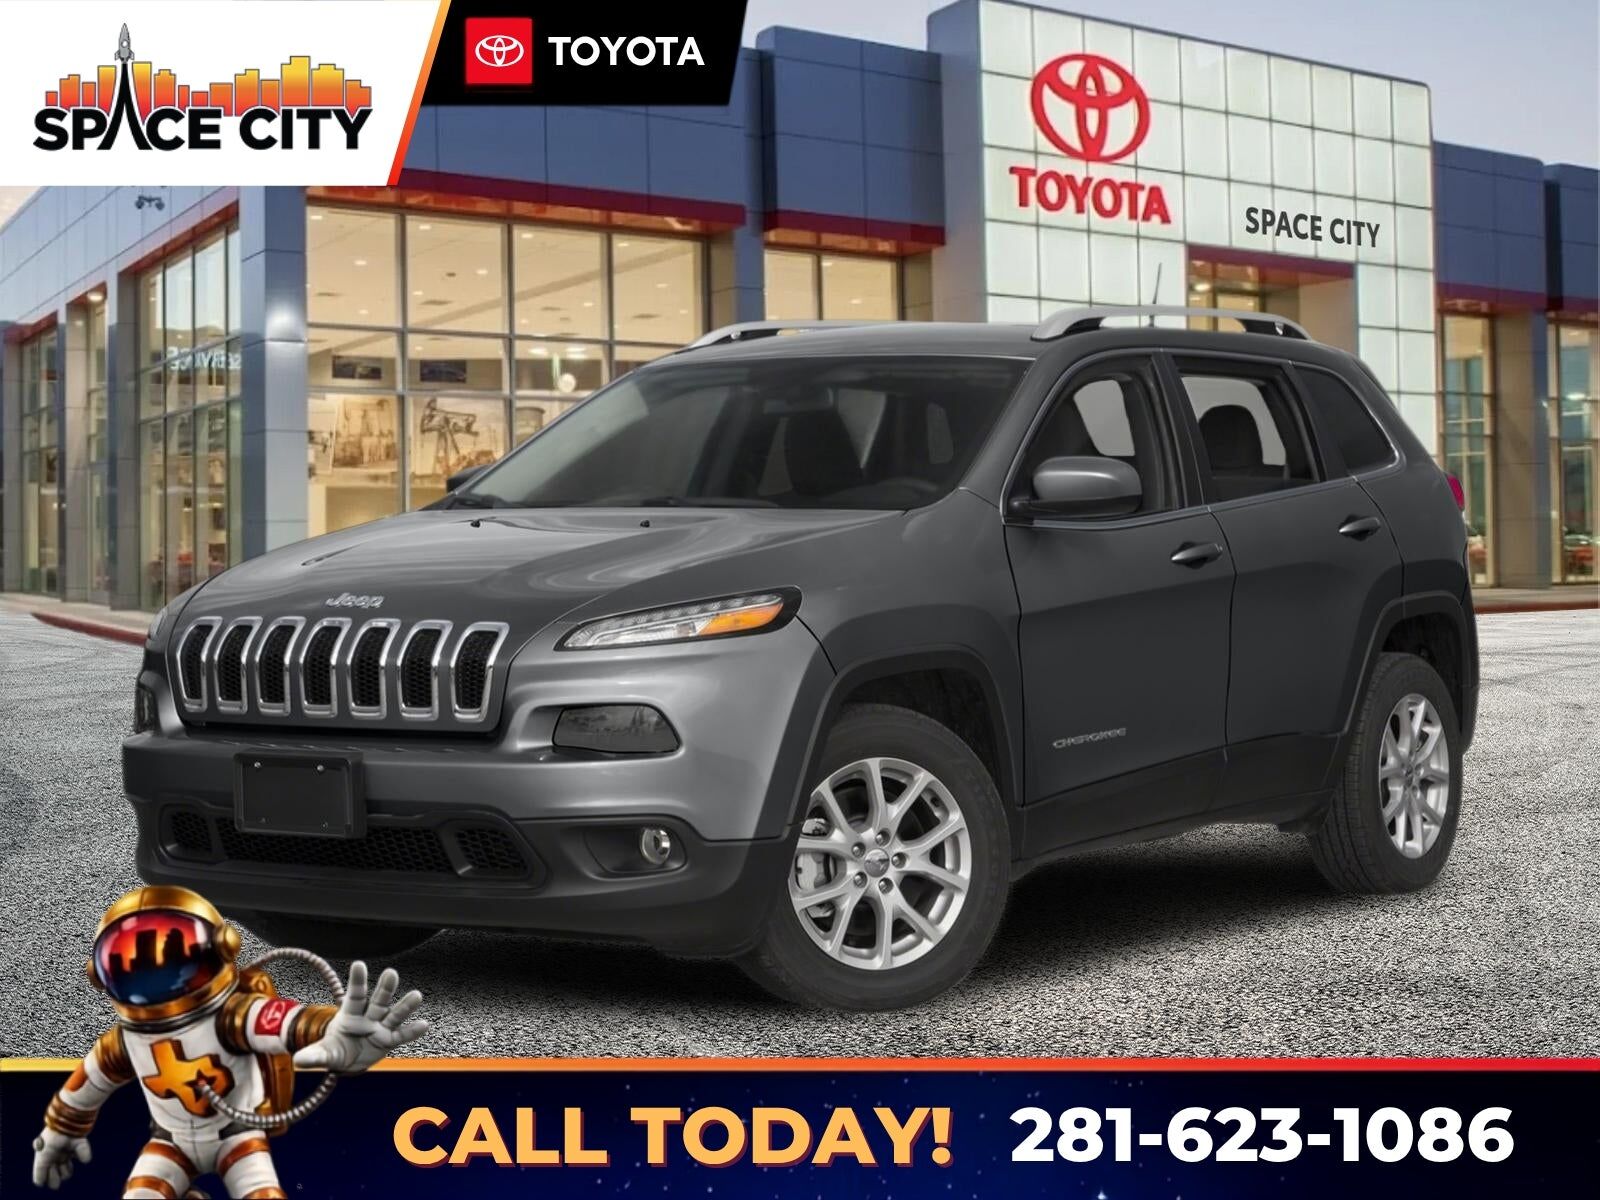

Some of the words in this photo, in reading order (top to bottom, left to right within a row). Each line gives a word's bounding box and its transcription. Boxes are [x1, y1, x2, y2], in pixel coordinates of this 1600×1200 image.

[1009, 165, 1172, 225] TOYOTA
[1245, 206, 1323, 242] SPACE
[1329, 217, 1381, 248] CITY
[324, 591, 385, 609] Jeep
[1051, 727, 1127, 749] CHEROKEE
